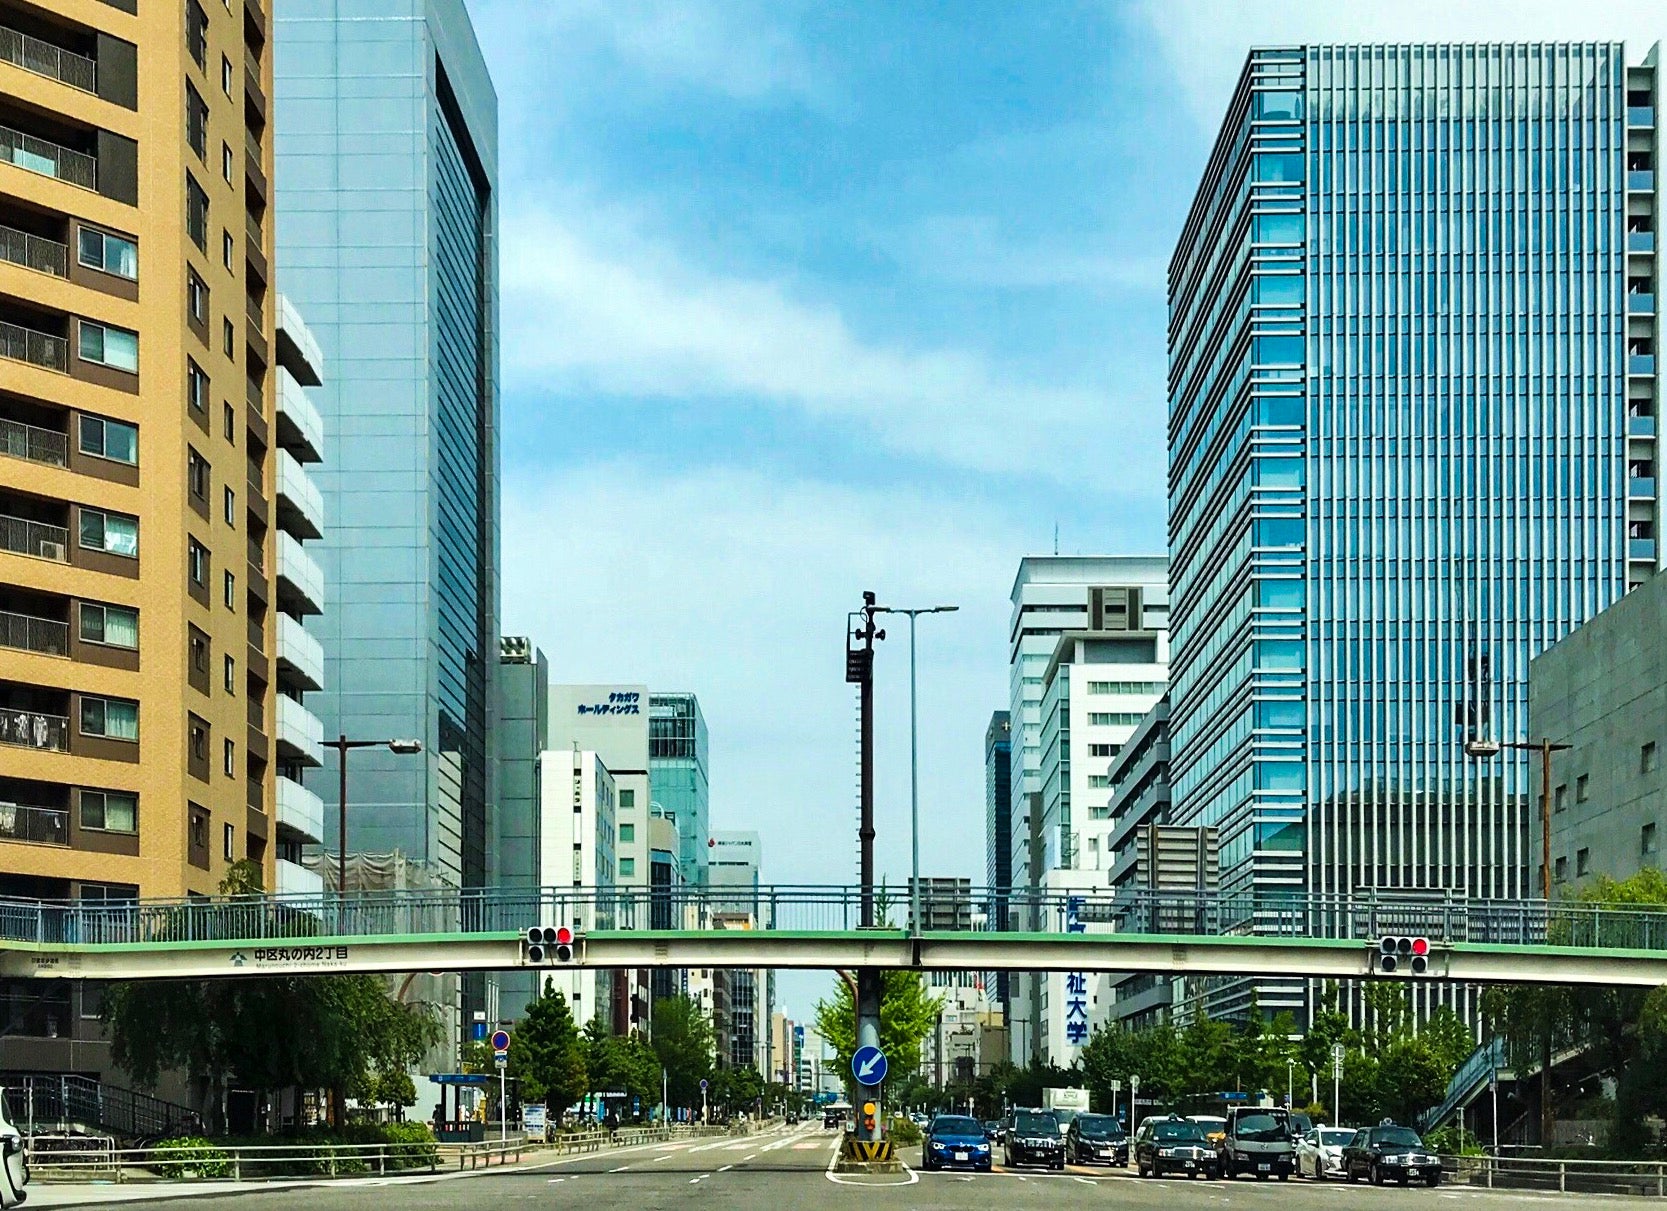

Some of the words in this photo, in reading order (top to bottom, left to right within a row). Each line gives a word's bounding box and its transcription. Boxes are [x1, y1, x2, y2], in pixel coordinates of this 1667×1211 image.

[609, 692, 640, 703] タカガワ
[578, 704, 640, 715] ホールディングス
[254, 946, 348, 961] 中区丸の内2丁目
